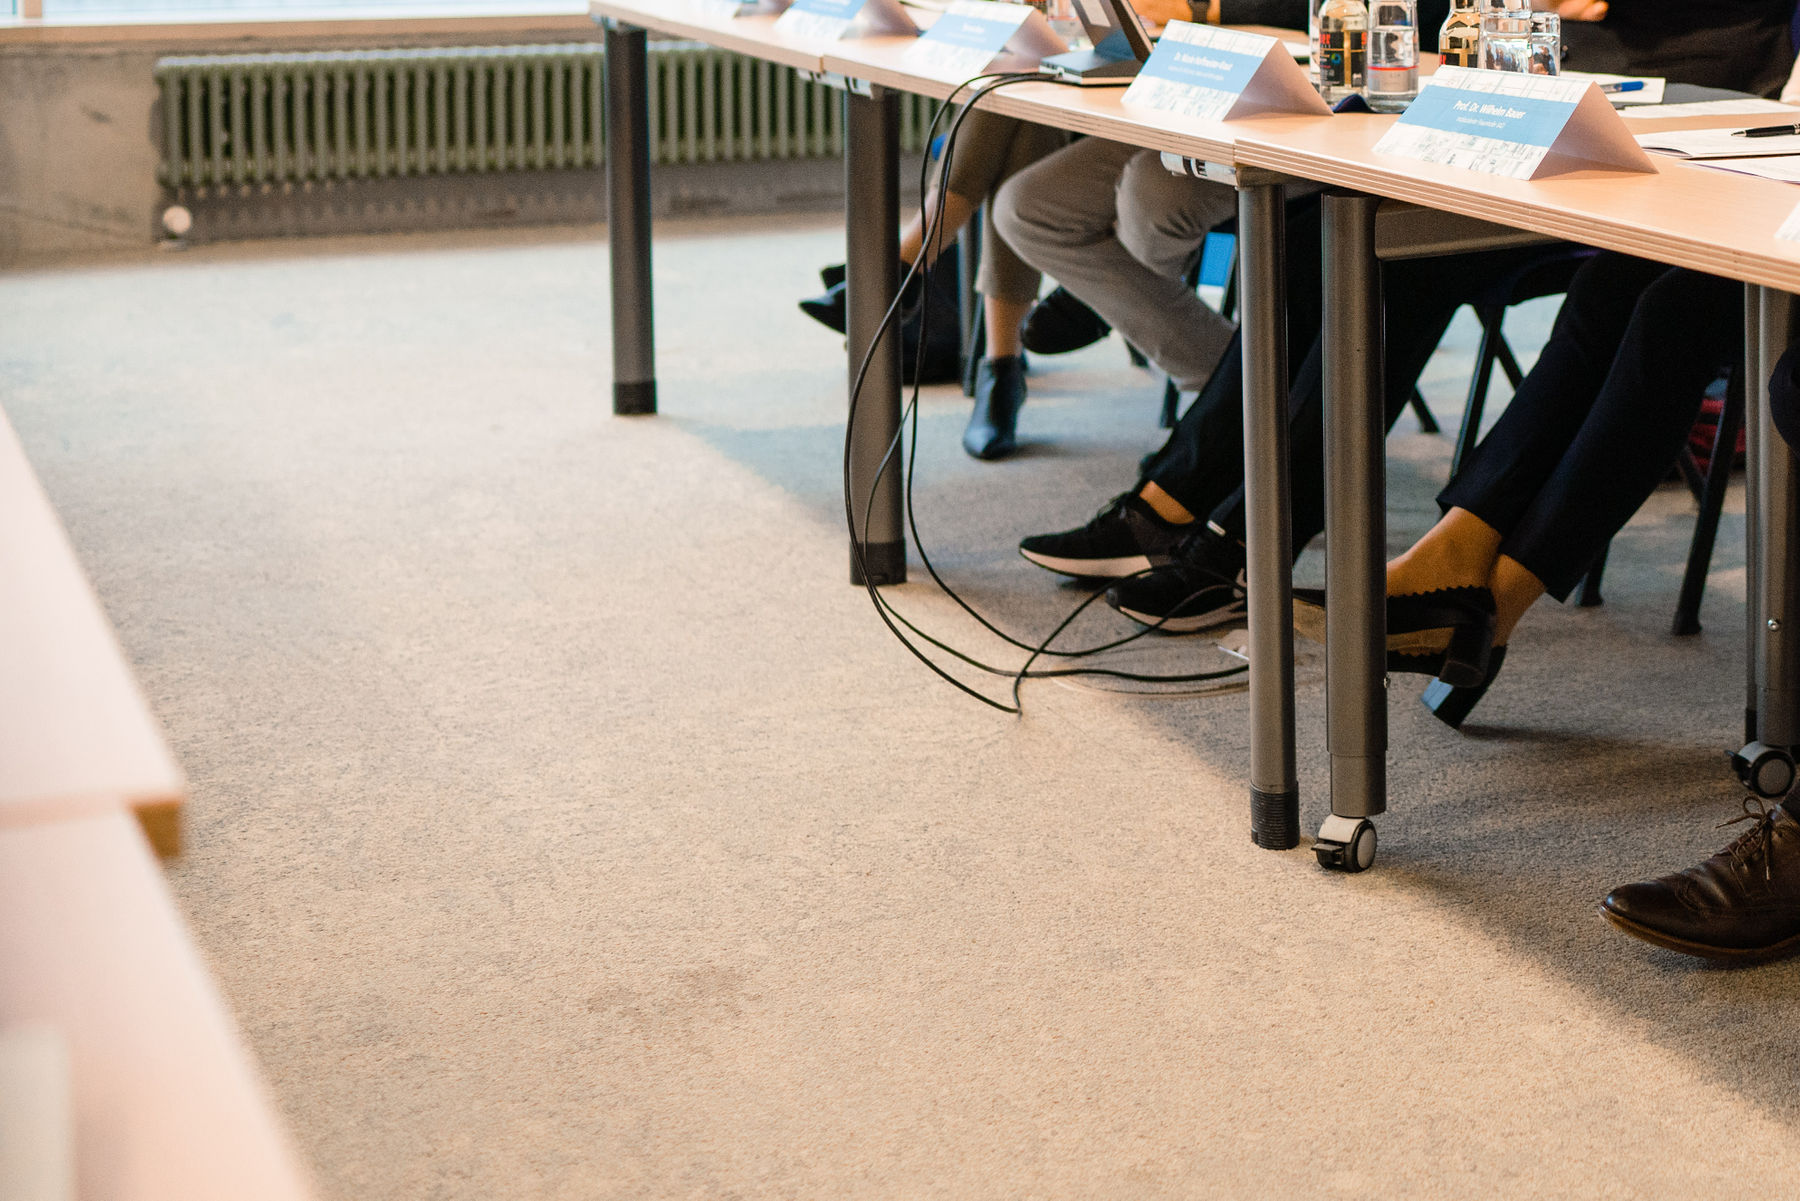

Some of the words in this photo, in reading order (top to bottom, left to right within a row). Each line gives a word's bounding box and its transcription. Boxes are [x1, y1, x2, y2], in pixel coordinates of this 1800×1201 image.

[1453, 100, 1471, 111] Prof.
[1470, 102, 1479, 112] Dr.
[1480, 103, 1505, 115] Wilhelm
[1504, 107, 1526, 119] Bauer
